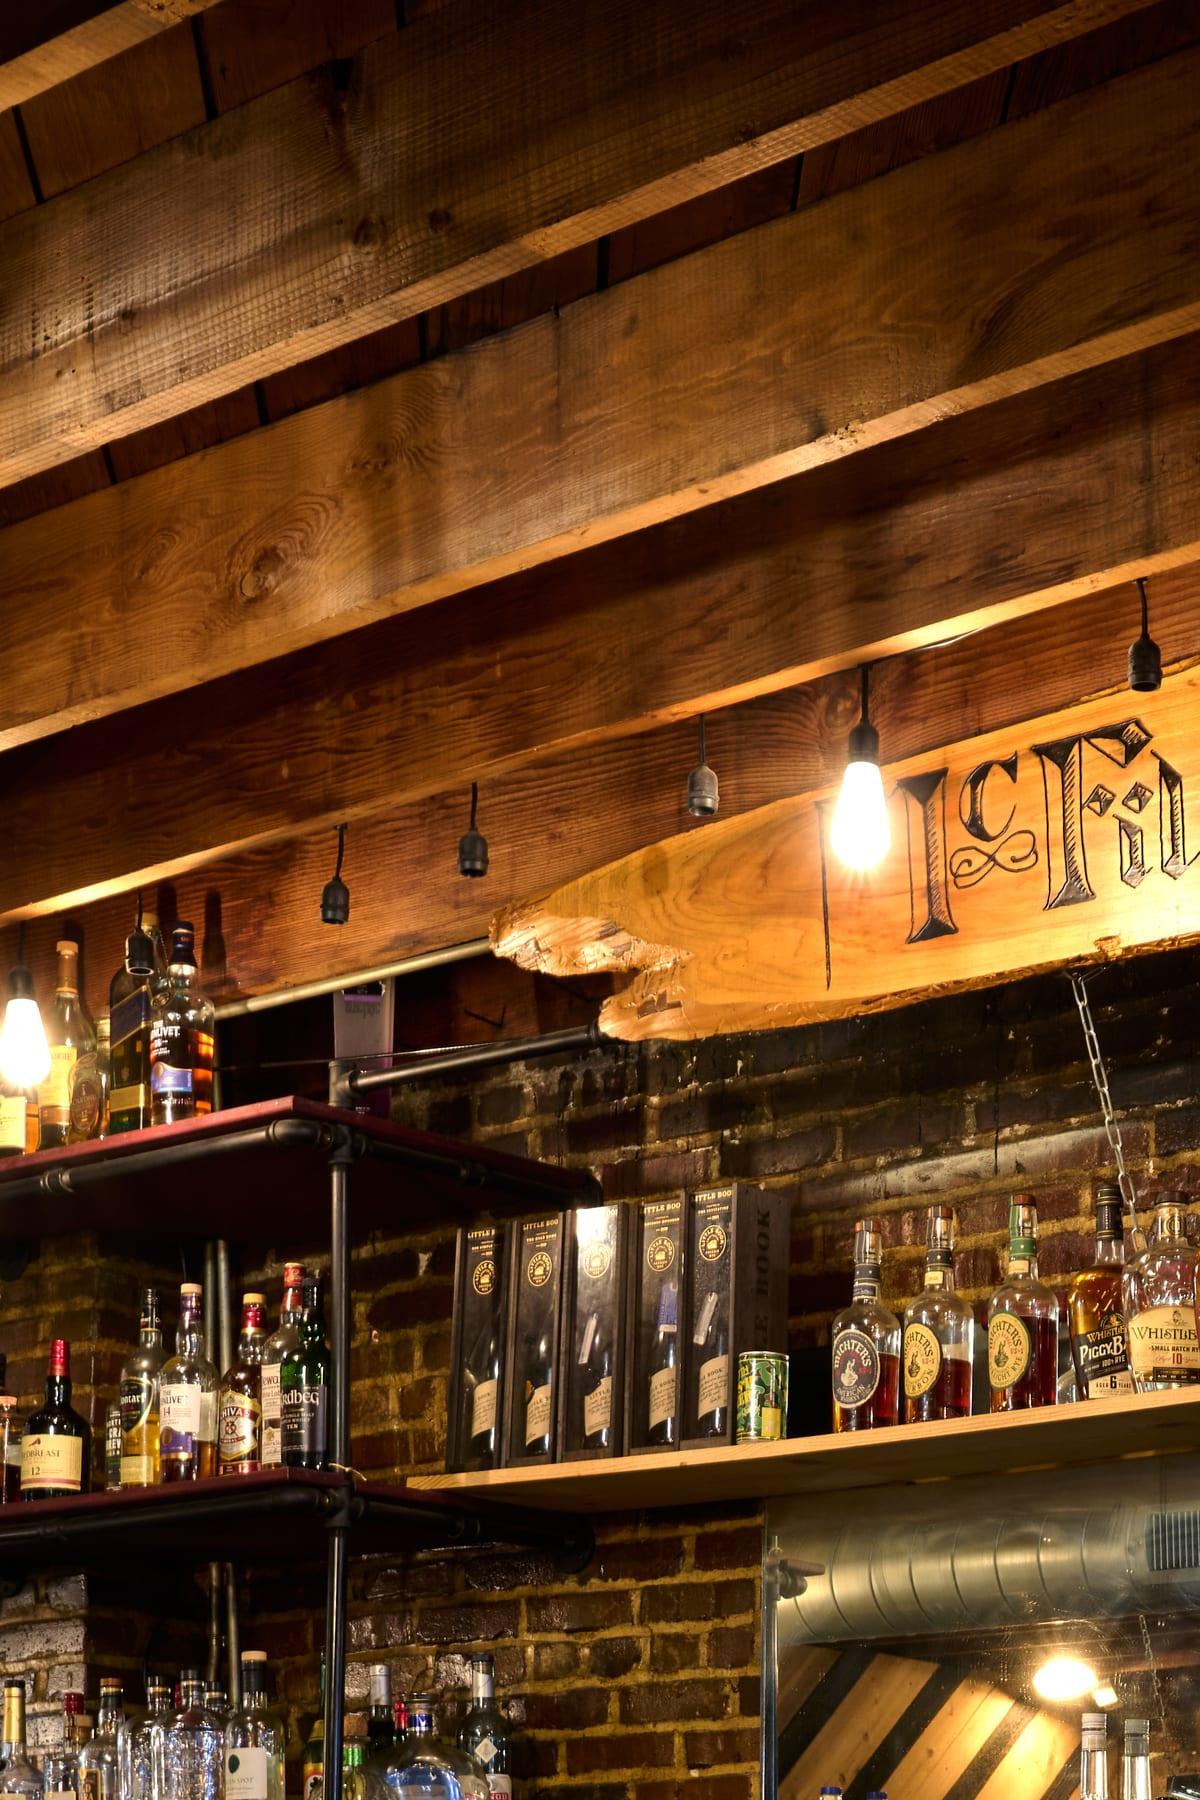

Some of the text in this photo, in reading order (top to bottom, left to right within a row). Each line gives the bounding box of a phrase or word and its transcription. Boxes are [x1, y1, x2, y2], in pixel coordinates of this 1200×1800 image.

[694, 1188, 732, 1203] ITTLE BOO
[644, 1202, 681, 1215] ITTLE BOO
[523, 1218, 559, 1231] LITTLE BOO
[467, 1229, 491, 1239] LITTLE
[1086, 1326, 1126, 1343] WHISTLE
[1131, 1326, 1198, 1341] WHISTLE
[1114, 1355, 1127, 1365] RYE
[1172, 1353, 1183, 1364] 10
[1109, 1375, 1117, 1389] 6
[221, 1406, 250, 1421] HIVAS
[22, 1449, 61, 1460] EDBREAST
[30, 1466, 41, 1476] 12
